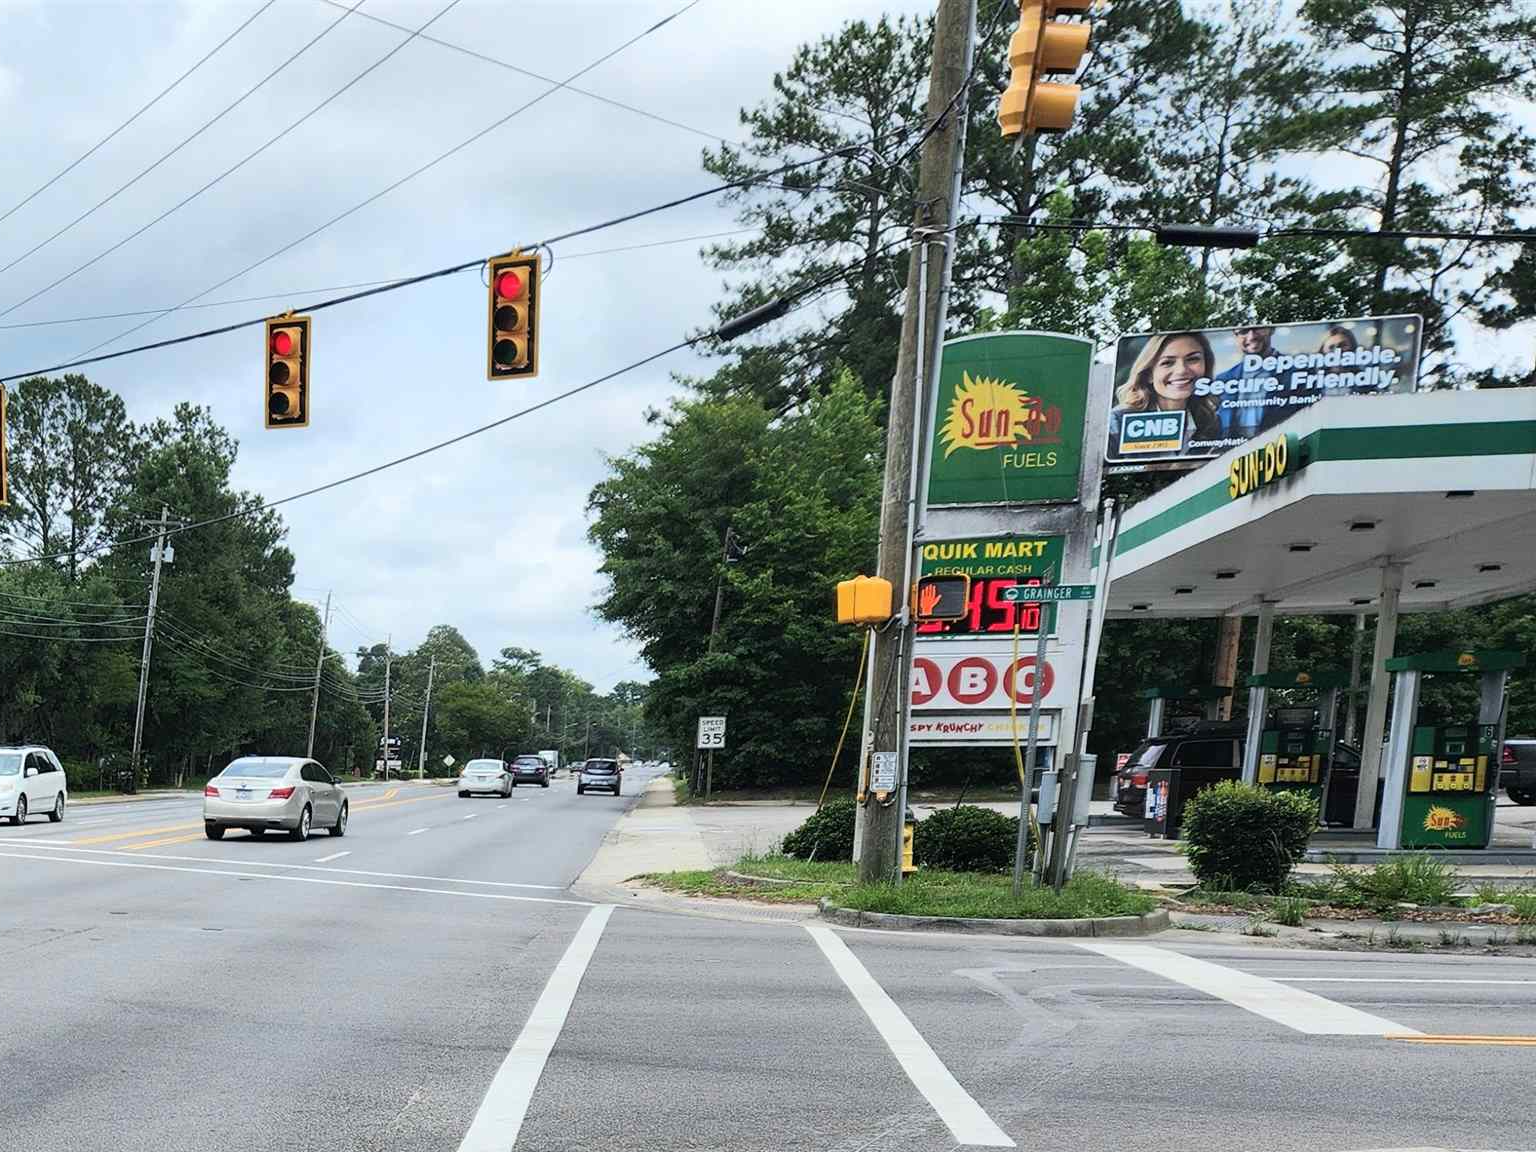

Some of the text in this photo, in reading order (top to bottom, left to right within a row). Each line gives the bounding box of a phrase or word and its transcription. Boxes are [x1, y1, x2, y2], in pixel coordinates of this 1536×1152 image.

[1243, 346, 1401, 373] Dependable.
[1194, 366, 1399, 396] Secure. Friendly.
[1221, 396, 1288, 409] Community
[1126, 418, 1179, 438] CNB
[1003, 452, 1057, 468] FUELS
[1230, 433, 1287, 498] SUN-DO
[923, 541, 1047, 560] QUIK MART
[935, 564, 1032, 576] REGULAR CASH
[1023, 587, 1072, 600] GRAINGER
[935, 722, 984, 733] KRUNCHY
[702, 733, 722, 744] 35
